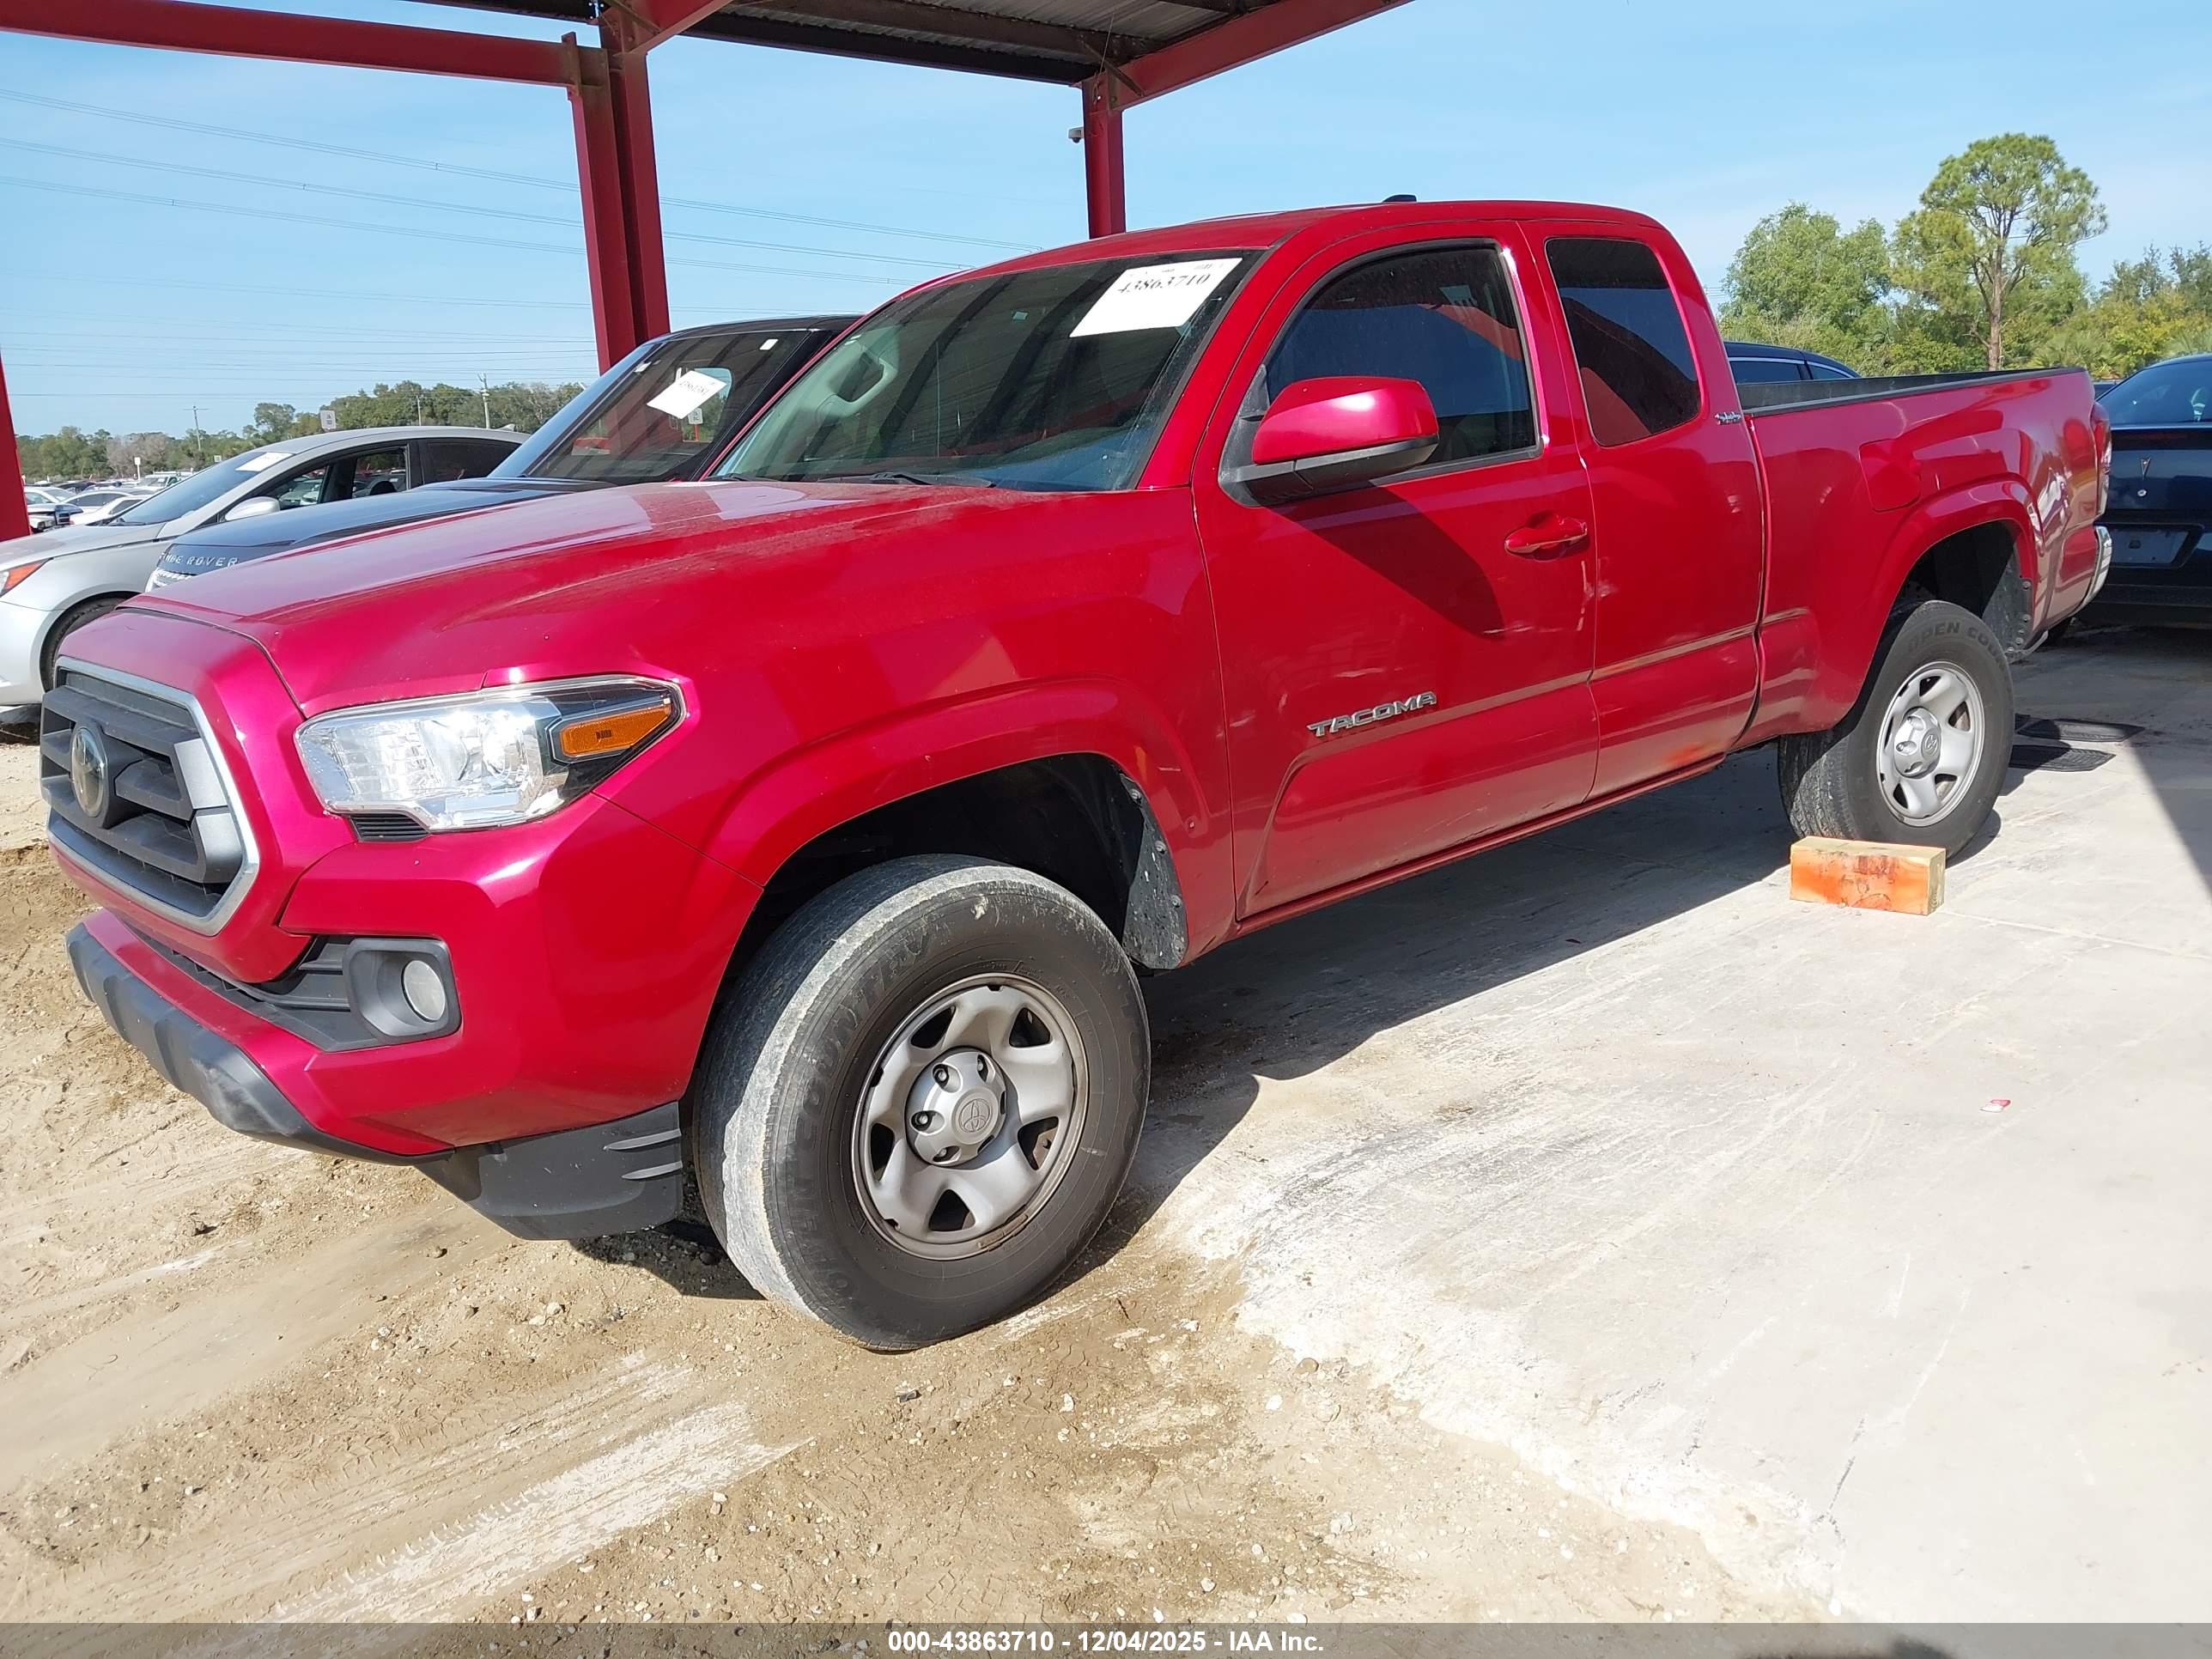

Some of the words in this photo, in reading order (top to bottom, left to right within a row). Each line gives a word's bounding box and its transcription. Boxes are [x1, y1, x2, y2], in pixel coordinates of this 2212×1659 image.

[1118, 273, 1211, 293] 43863710
[186, 556, 238, 567] ROVER
[1307, 691, 1437, 737] TACOMA
